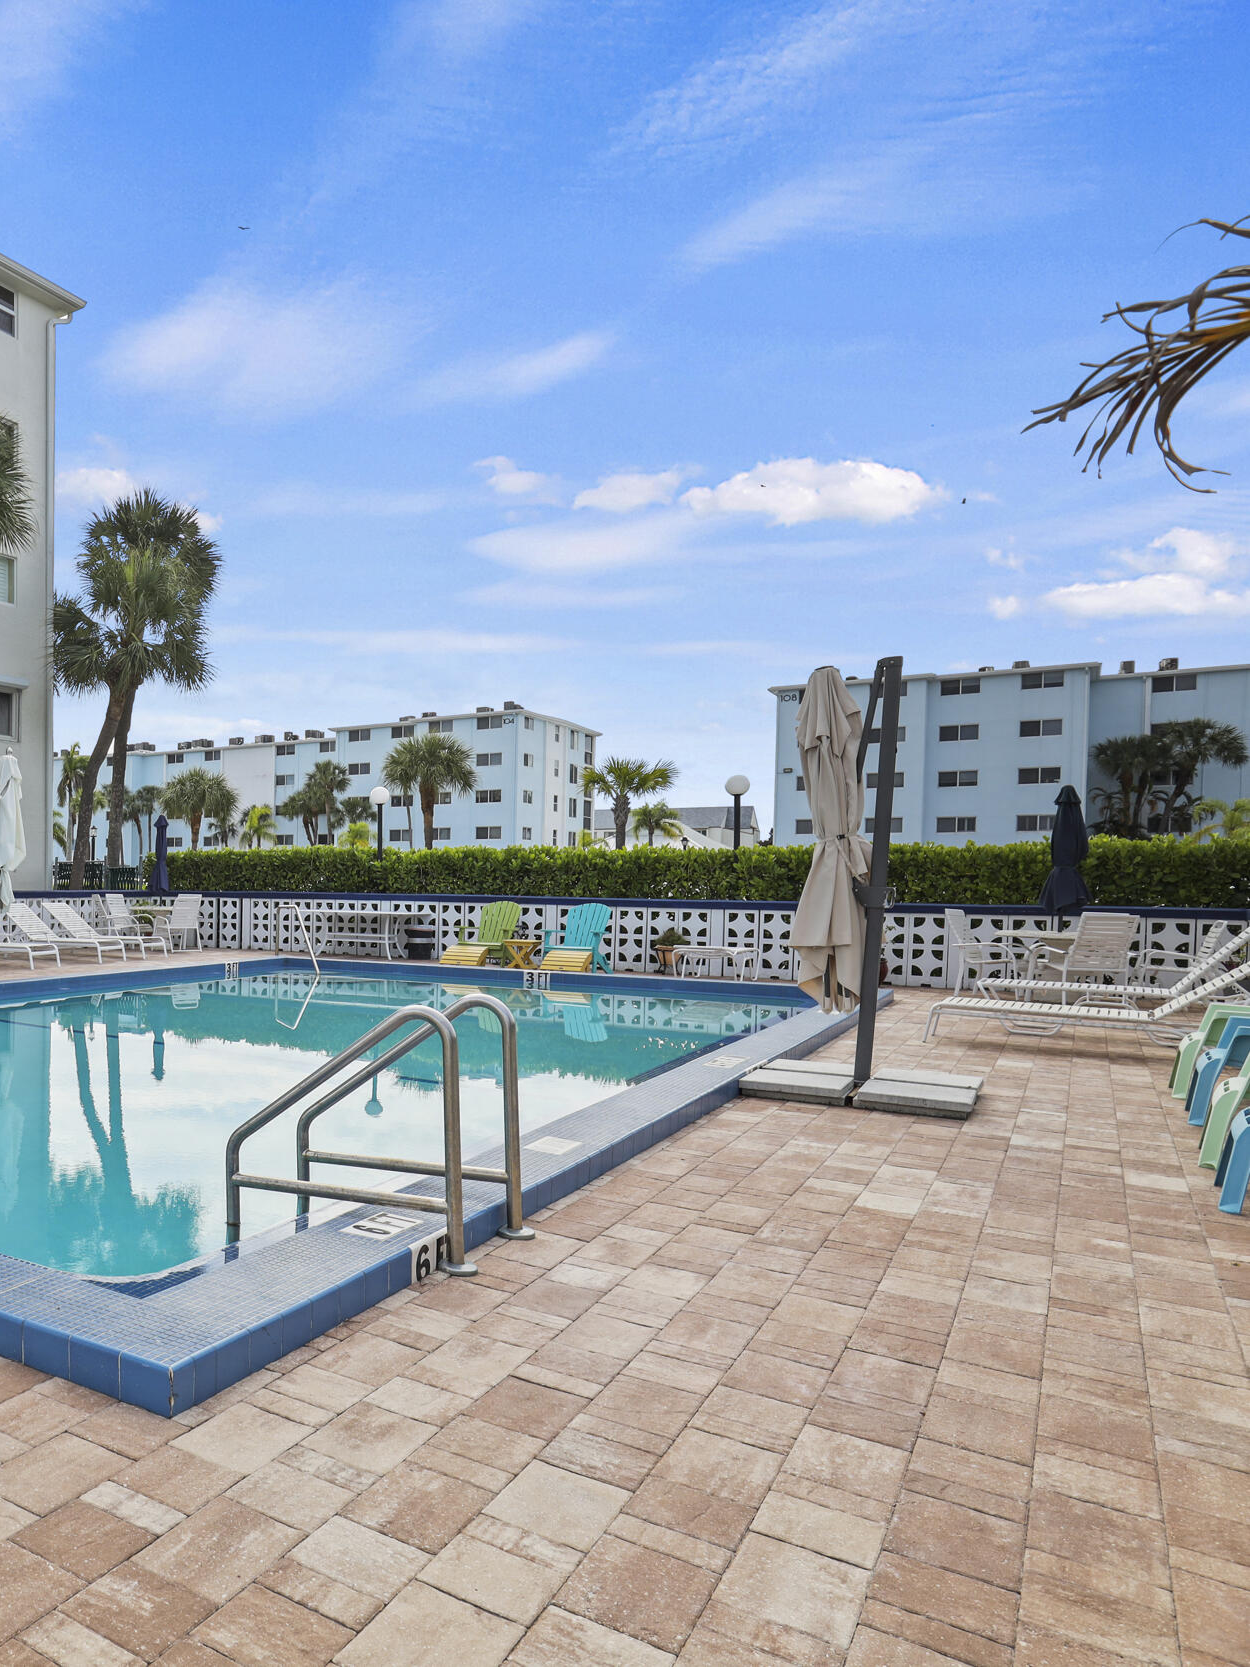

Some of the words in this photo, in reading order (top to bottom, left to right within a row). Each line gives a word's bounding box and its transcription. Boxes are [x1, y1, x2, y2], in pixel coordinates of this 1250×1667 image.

[780, 694, 797, 702] 108
[226, 962, 231, 971] 3
[526, 972, 534, 982] 3
[538, 972, 549, 982] FT
[367, 1212, 417, 1229] FT
[352, 1224, 391, 1235] 6
[416, 1244, 430, 1282] 6
